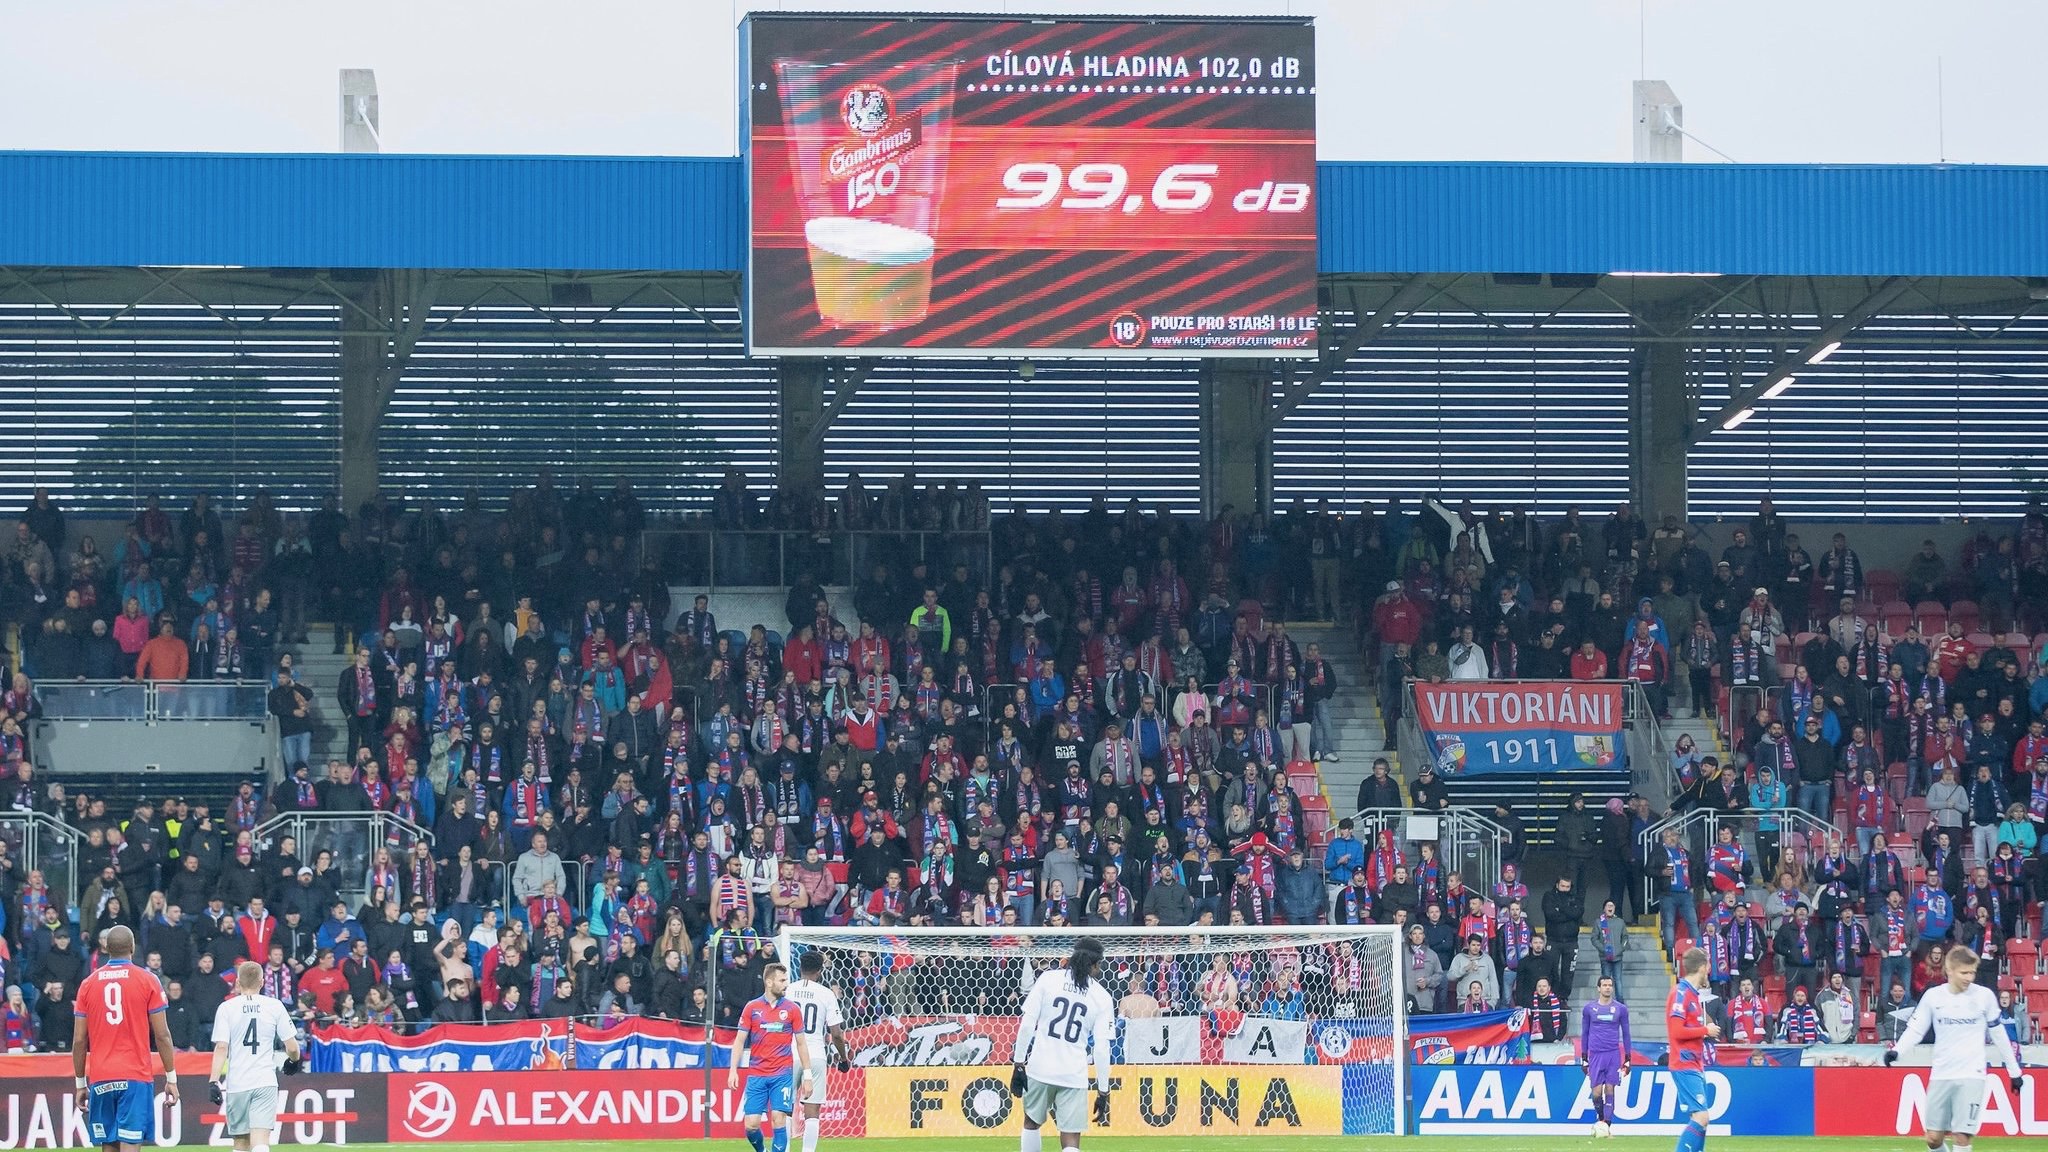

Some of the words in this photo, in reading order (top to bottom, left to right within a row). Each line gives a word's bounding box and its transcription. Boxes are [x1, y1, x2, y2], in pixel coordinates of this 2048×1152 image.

[986, 50, 1075, 77] CÍLOVÁ
[1083, 56, 1190, 78] HLADINA
[1198, 57, 1261, 82] 102,0
[1271, 57, 1300, 79] dB
[847, 162, 900, 212] 150
[996, 162, 1220, 215] 99,6
[1232, 181, 1311, 213] dB
[1151, 316, 1194, 331] POUZE
[1198, 316, 1226, 331] PRO
[1426, 687, 1612, 725] VIKTORIÁNI
[1485, 738, 1558, 765] 1911
[104, 981, 123, 1025] 9
[1047, 996, 1088, 1044] 26
[242, 1018, 260, 1055] 4
[1150, 1025, 1169, 1057] J
[1249, 1025, 1277, 1058] A
[1419, 1070, 1552, 1120] AAA
[1969, 1103, 1980, 1121] 17
[0, 1093, 94, 1150] JAK
